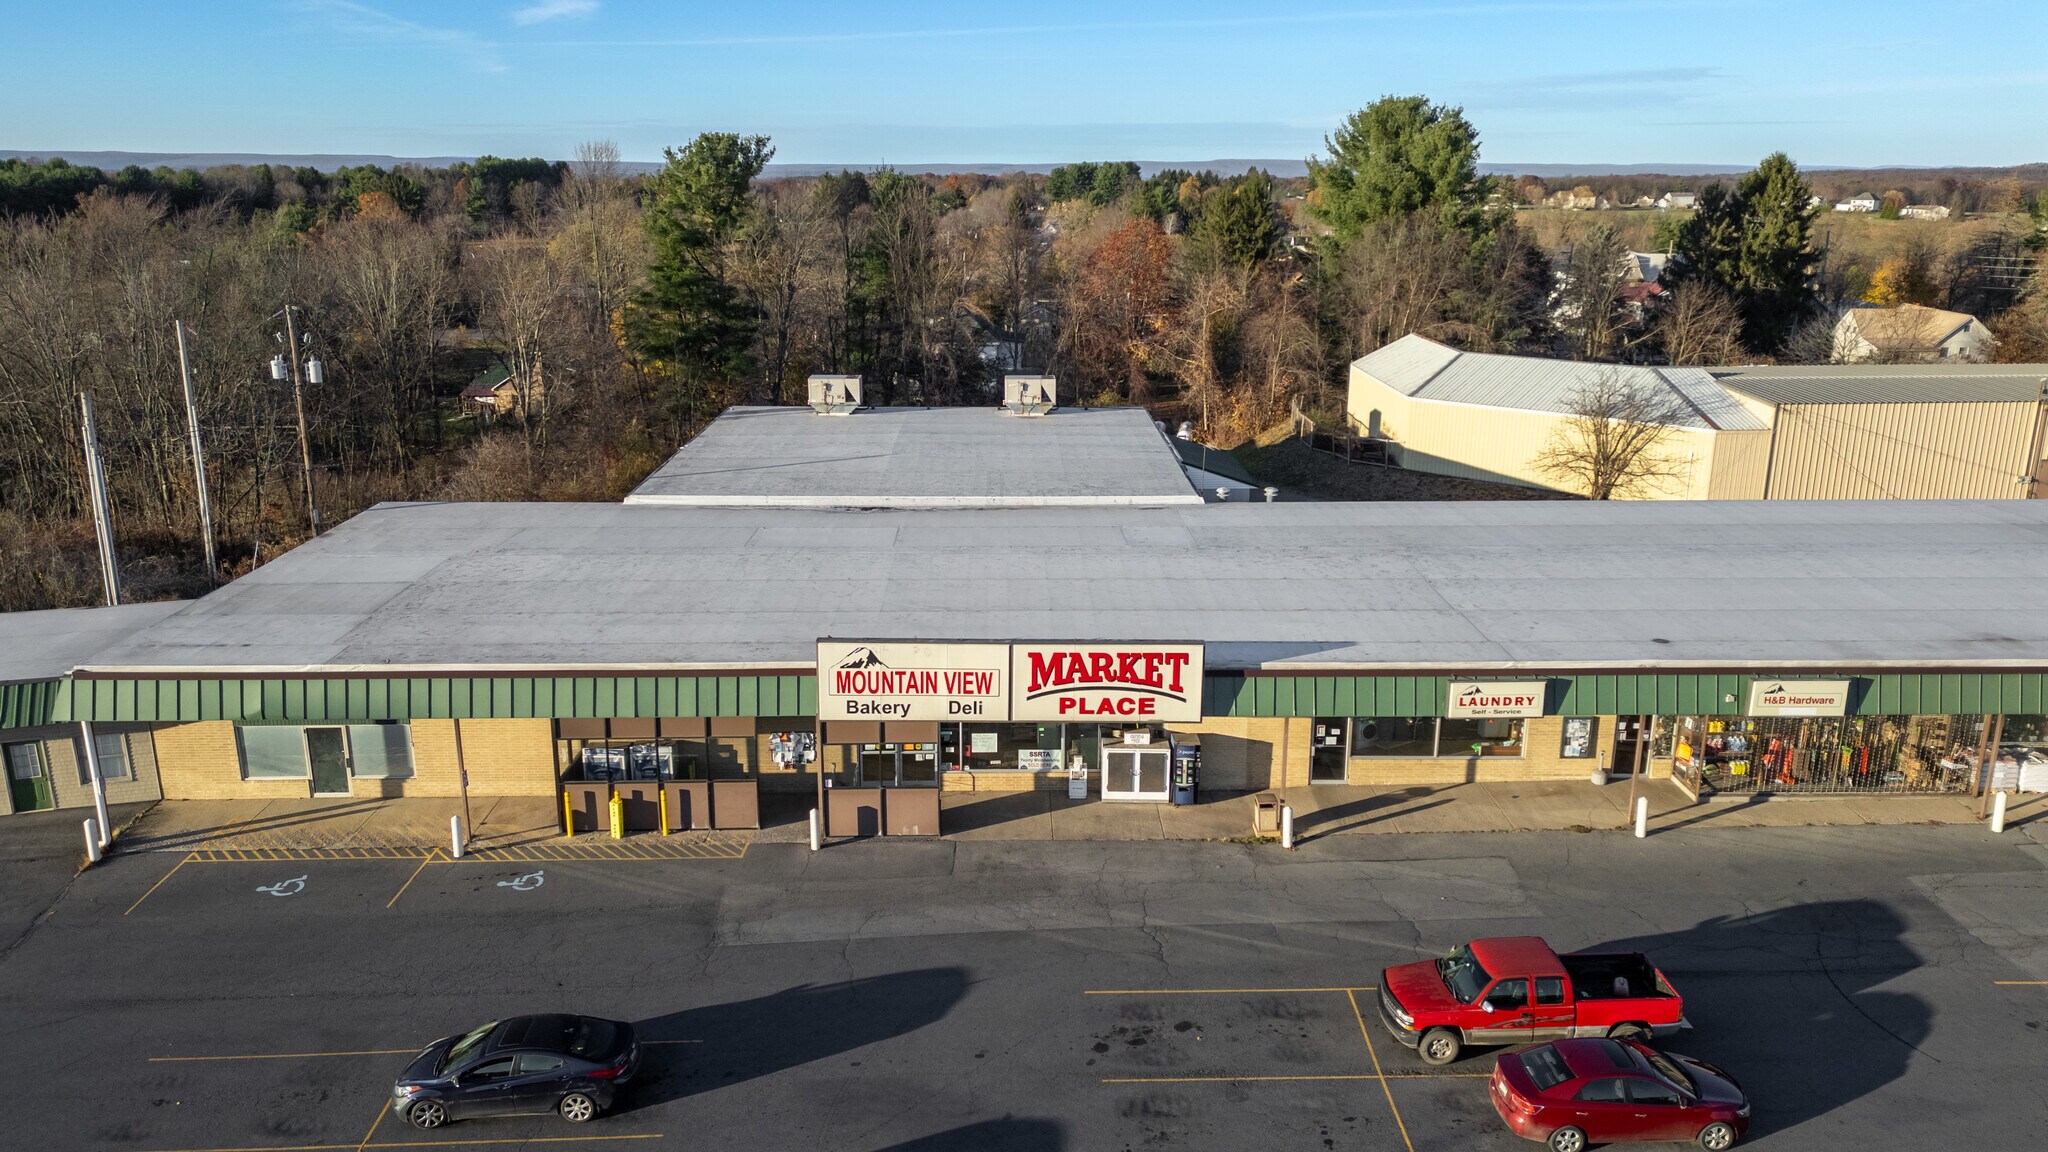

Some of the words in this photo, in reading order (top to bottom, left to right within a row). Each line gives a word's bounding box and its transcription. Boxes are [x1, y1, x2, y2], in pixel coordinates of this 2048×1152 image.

[1028, 652, 1189, 693] MARKET
[836, 670, 938, 694] MOUNTAIN
[944, 671, 993, 695] VIEW
[846, 700, 911, 718] Bakery
[949, 700, 983, 715] Deli
[1059, 697, 1156, 715] PLACE
[1459, 696, 1535, 707] LAUNDRY
[1764, 696, 1786, 705] H&B
[1789, 696, 1835, 705] Hardware
